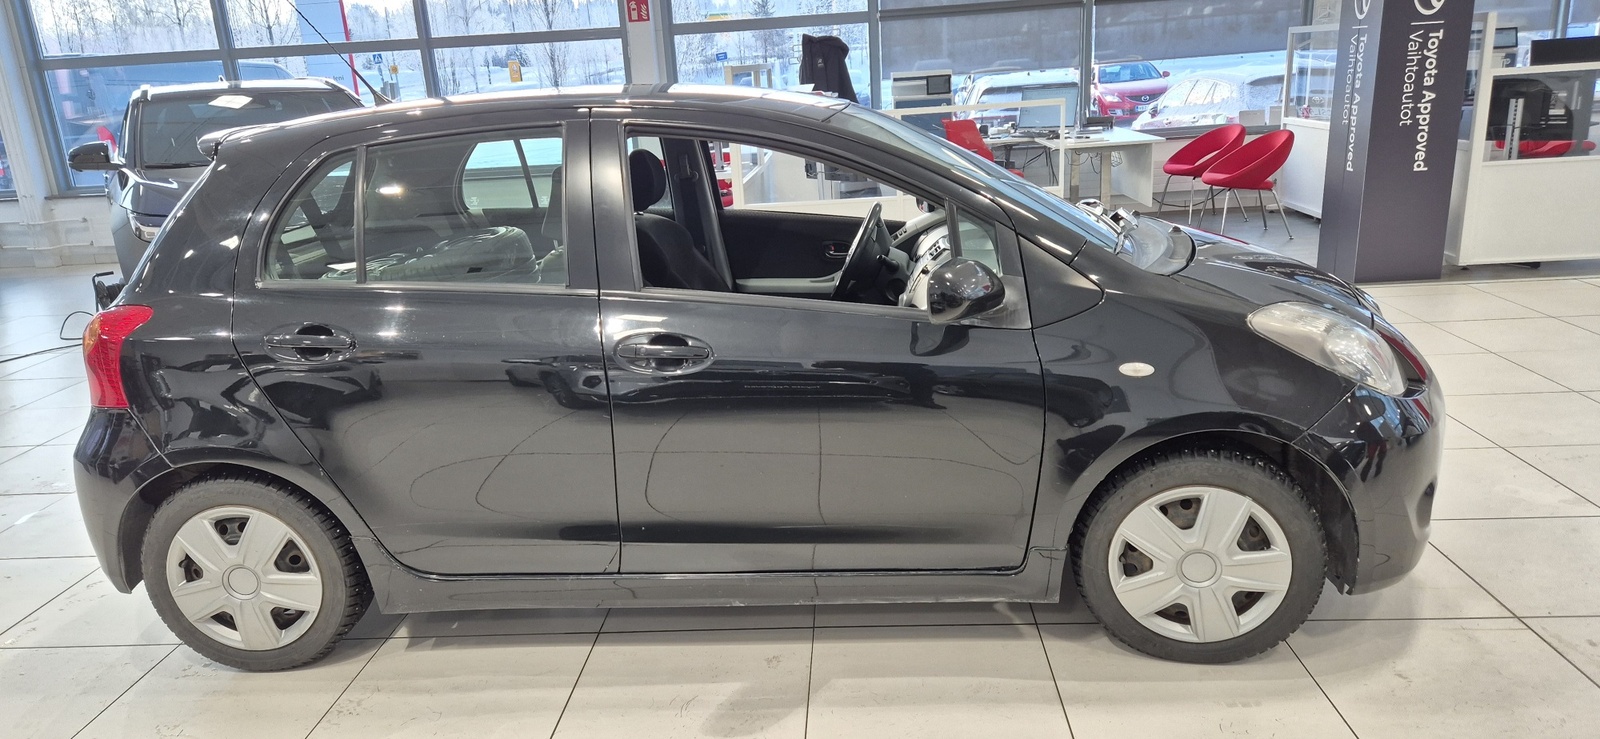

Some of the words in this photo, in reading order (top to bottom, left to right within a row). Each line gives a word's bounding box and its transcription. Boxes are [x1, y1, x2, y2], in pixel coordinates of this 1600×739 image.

[1342, 34, 1358, 125] Vaihtoautot
[1355, 33, 1368, 88] Toyota
[1399, 29, 1424, 126] Vaihtoautot
[1423, 29, 1444, 86] Toyota
[1346, 93, 1361, 171] Approved
[1413, 91, 1436, 171] Approved
